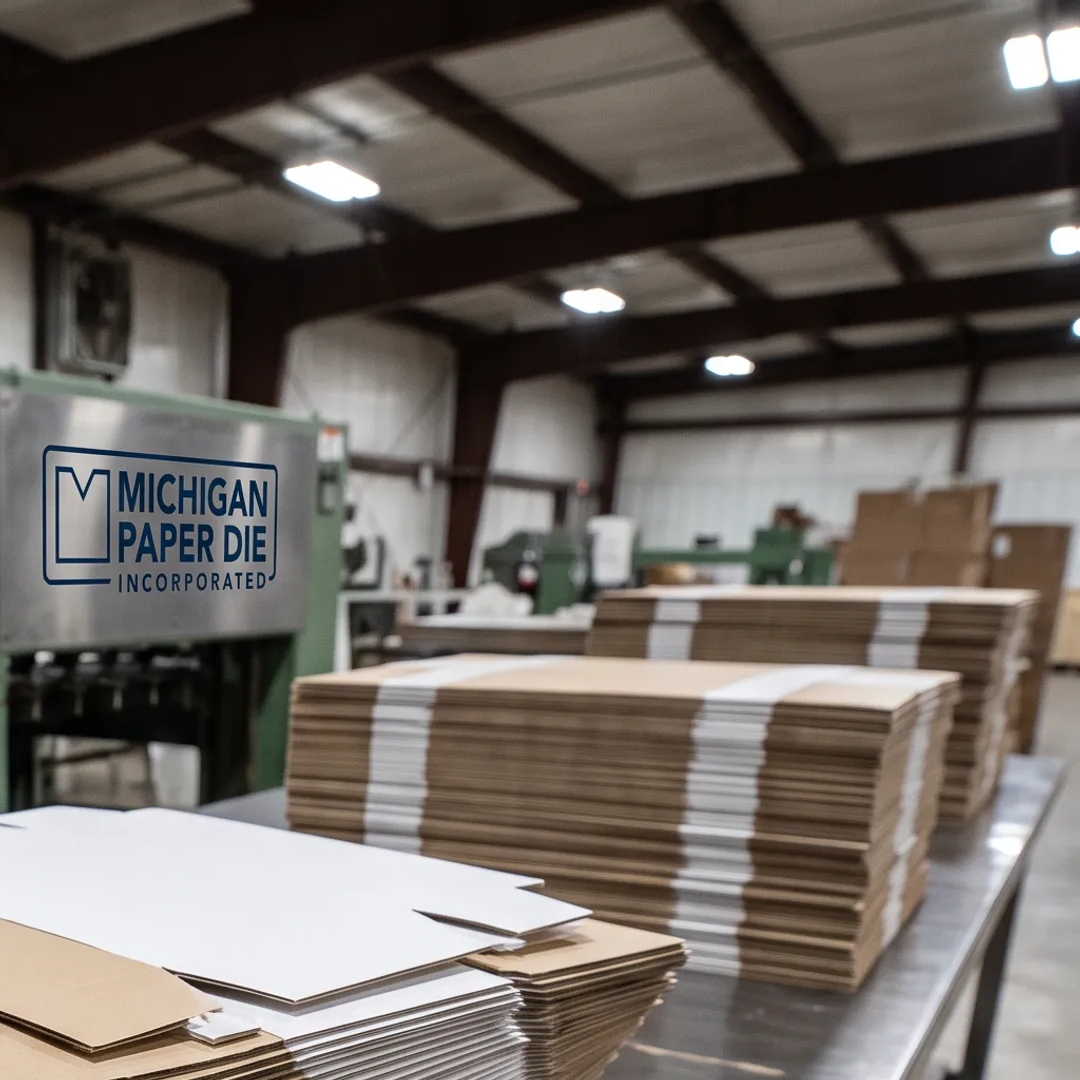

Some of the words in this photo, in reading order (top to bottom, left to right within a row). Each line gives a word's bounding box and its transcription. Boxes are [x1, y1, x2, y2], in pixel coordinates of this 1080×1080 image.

[118, 471, 268, 517] MICHIGAN
[118, 522, 214, 563] PAPER
[223, 525, 267, 563] DIE
[118, 572, 266, 593] INCORPORATED
